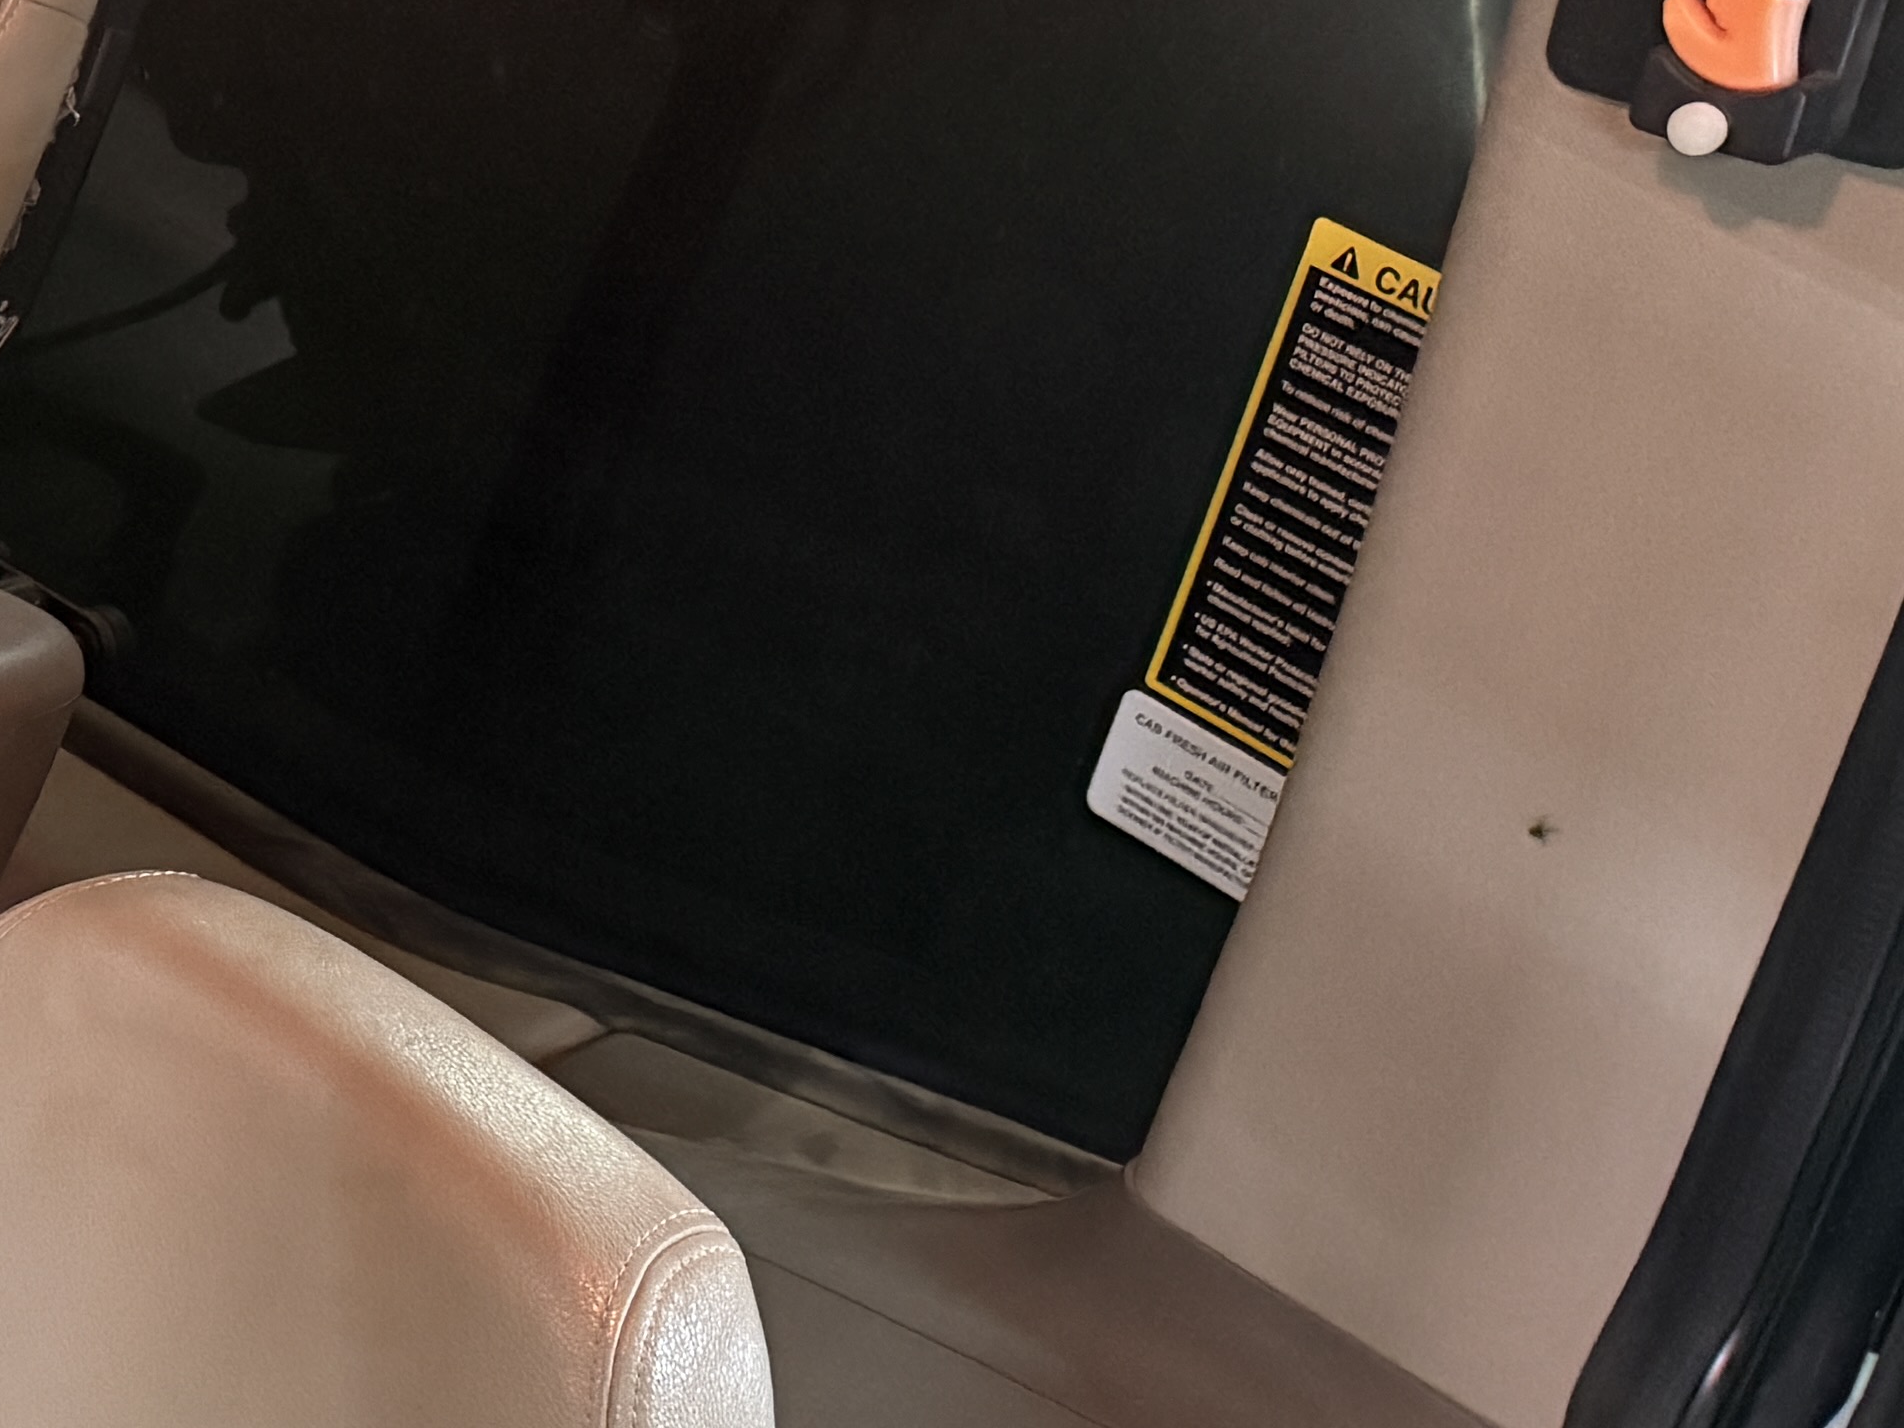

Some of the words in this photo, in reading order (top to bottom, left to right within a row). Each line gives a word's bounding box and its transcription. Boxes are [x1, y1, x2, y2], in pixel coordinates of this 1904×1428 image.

[1300, 417, 1355, 452] PERSONAL
[1134, 712, 1162, 735] CAB
[1164, 729, 1207, 760] FRESH
